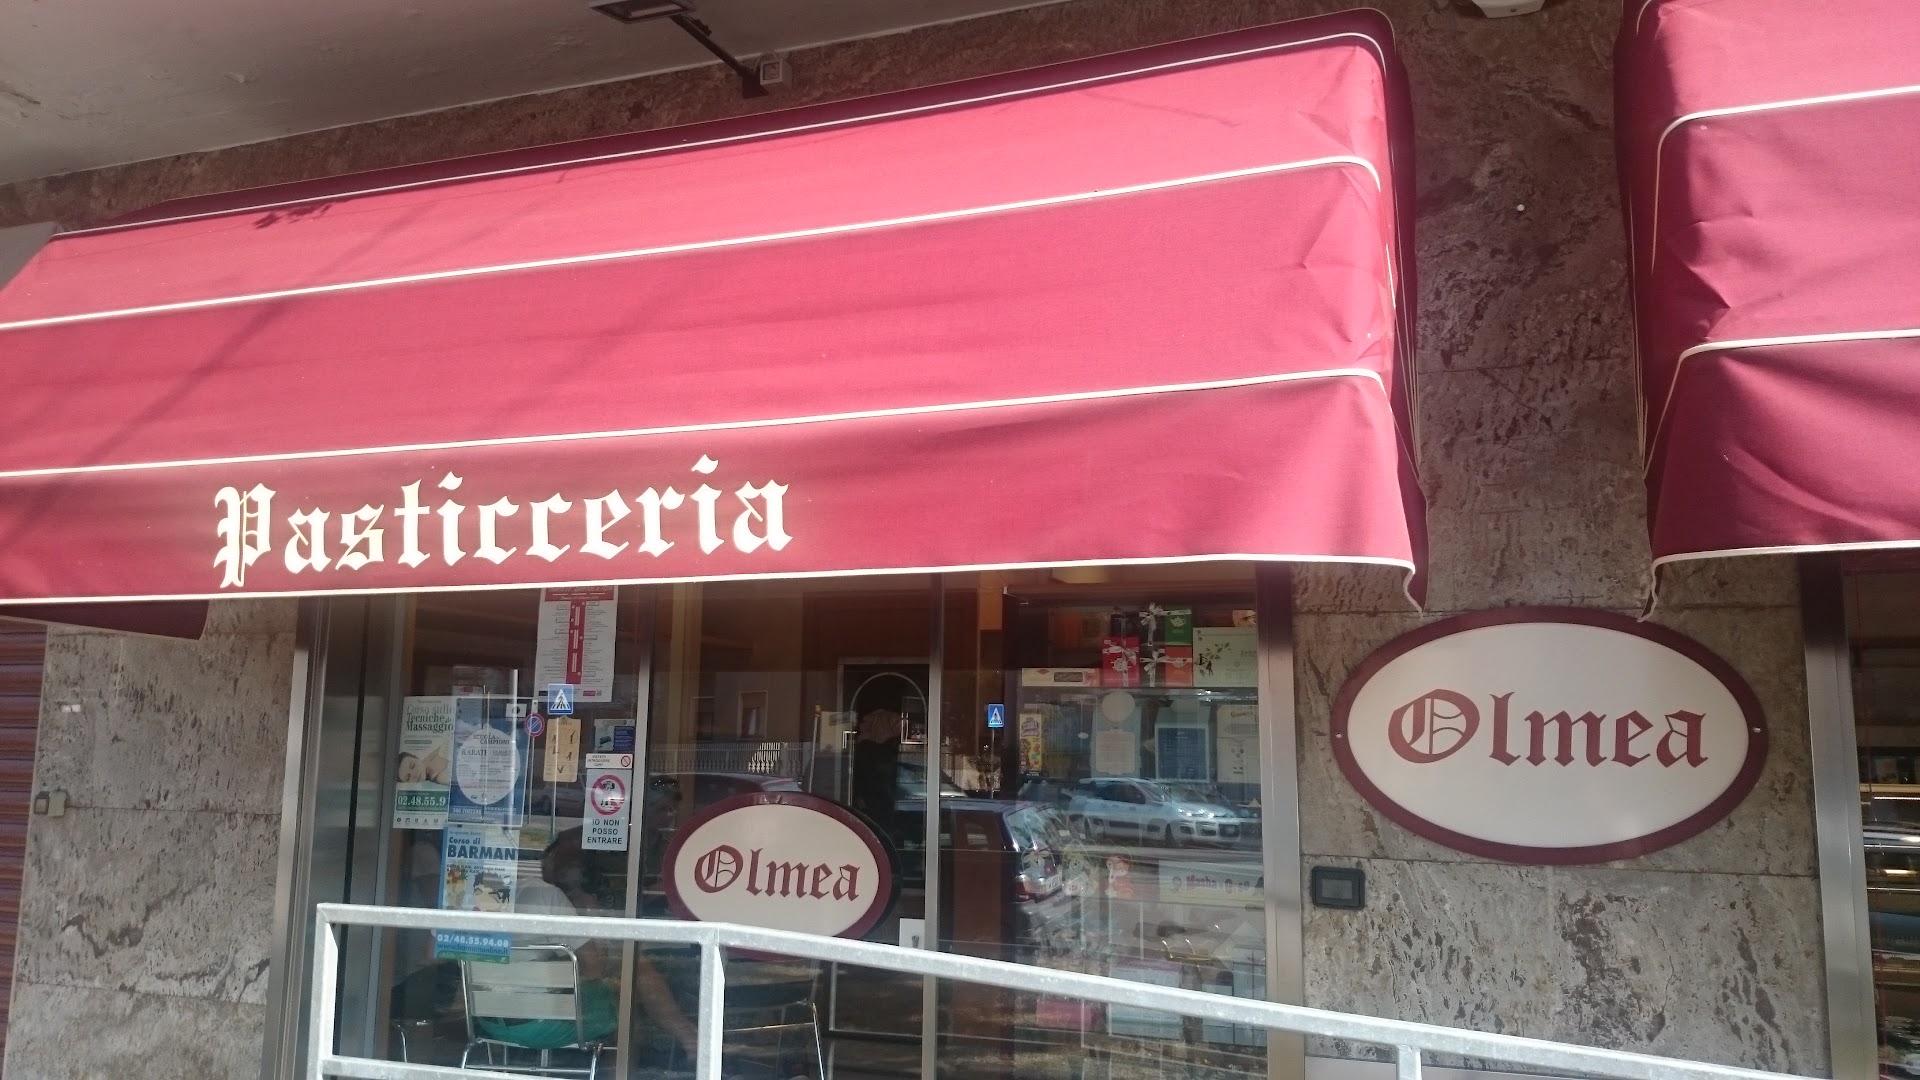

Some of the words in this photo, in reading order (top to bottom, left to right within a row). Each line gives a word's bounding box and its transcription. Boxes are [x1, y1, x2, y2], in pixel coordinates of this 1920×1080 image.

[214, 454, 795, 589] Pasticceria
[406, 712, 445, 723] Tecniche
[406, 720, 454, 733] Massaggio
[1387, 689, 1710, 769] Olmea
[592, 827, 619, 835] POSSO
[449, 836, 470, 845] Corso
[473, 837, 481, 845] di
[587, 836, 623, 844] ENTRARE
[447, 844, 517, 861] BARMAN
[694, 845, 860, 902] Olmea
[437, 934, 509, 948] 02/48.55.94.08
